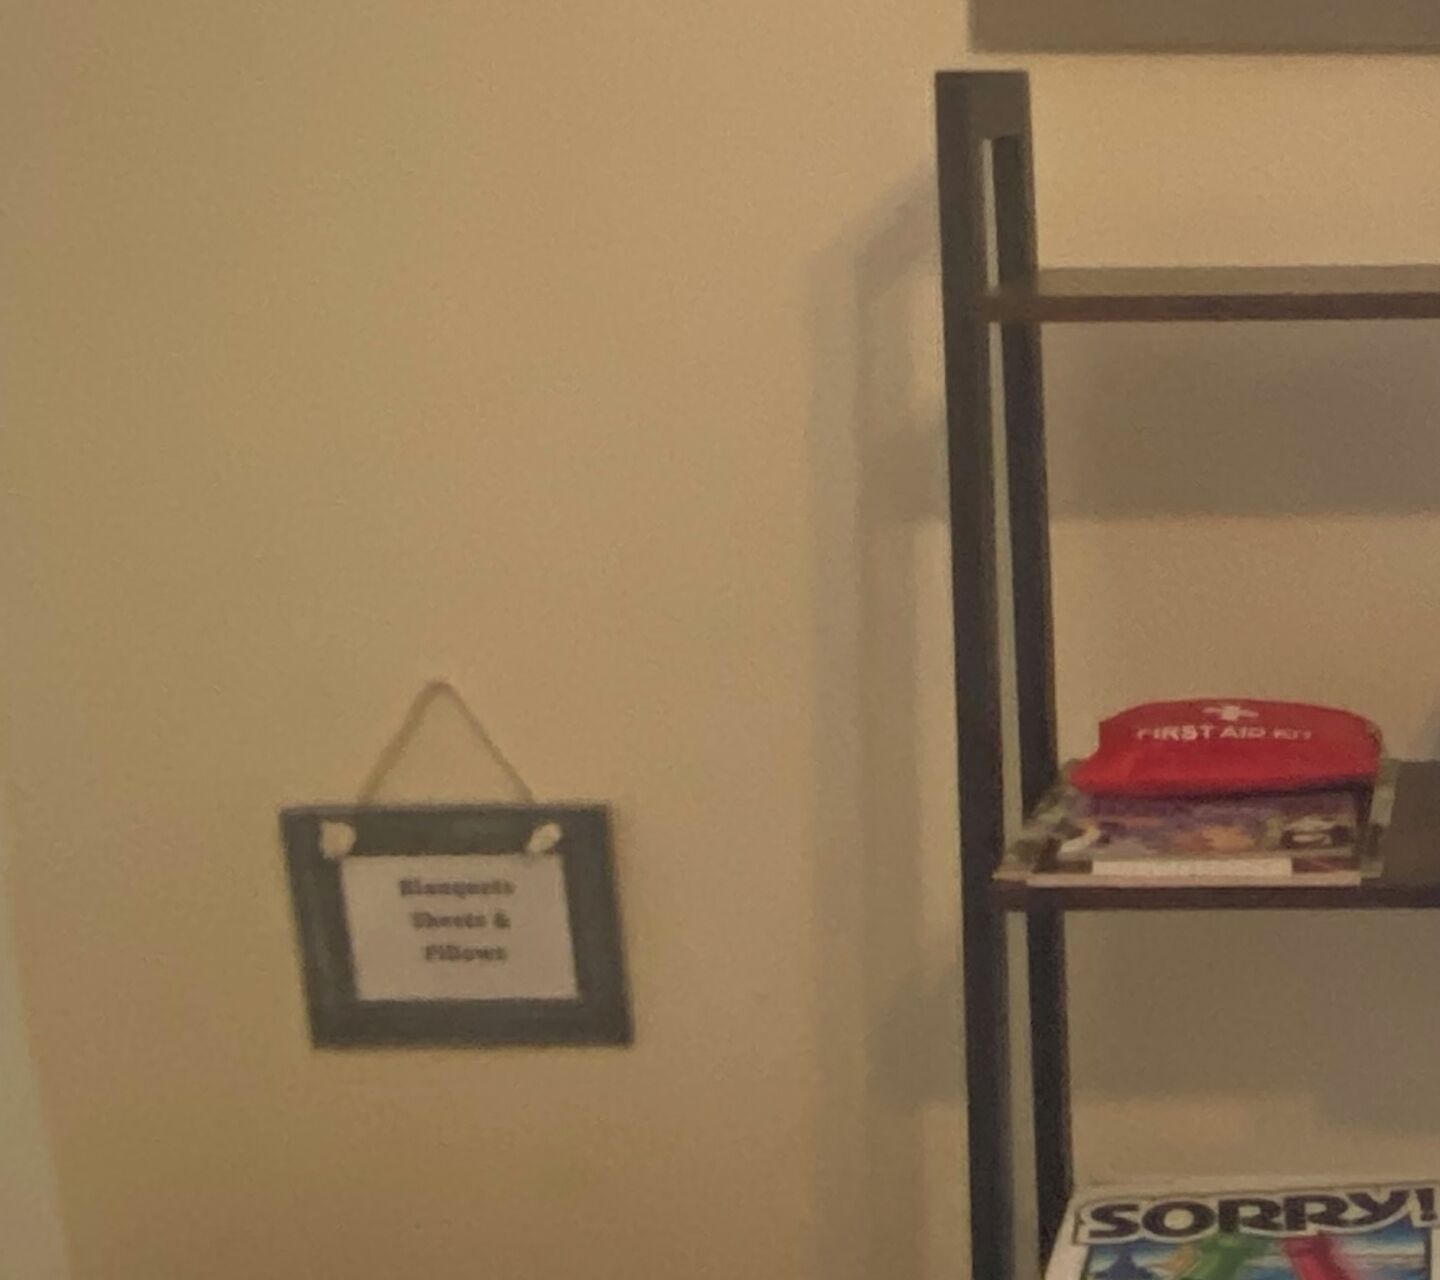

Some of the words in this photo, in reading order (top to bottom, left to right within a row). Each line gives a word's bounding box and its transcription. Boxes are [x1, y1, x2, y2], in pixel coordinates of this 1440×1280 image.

[1136, 724, 1216, 741] FIRST
[1219, 725, 1267, 739] AID
[424, 944, 508, 962] Pillows
[1087, 1187, 1437, 1241] SORRY!
